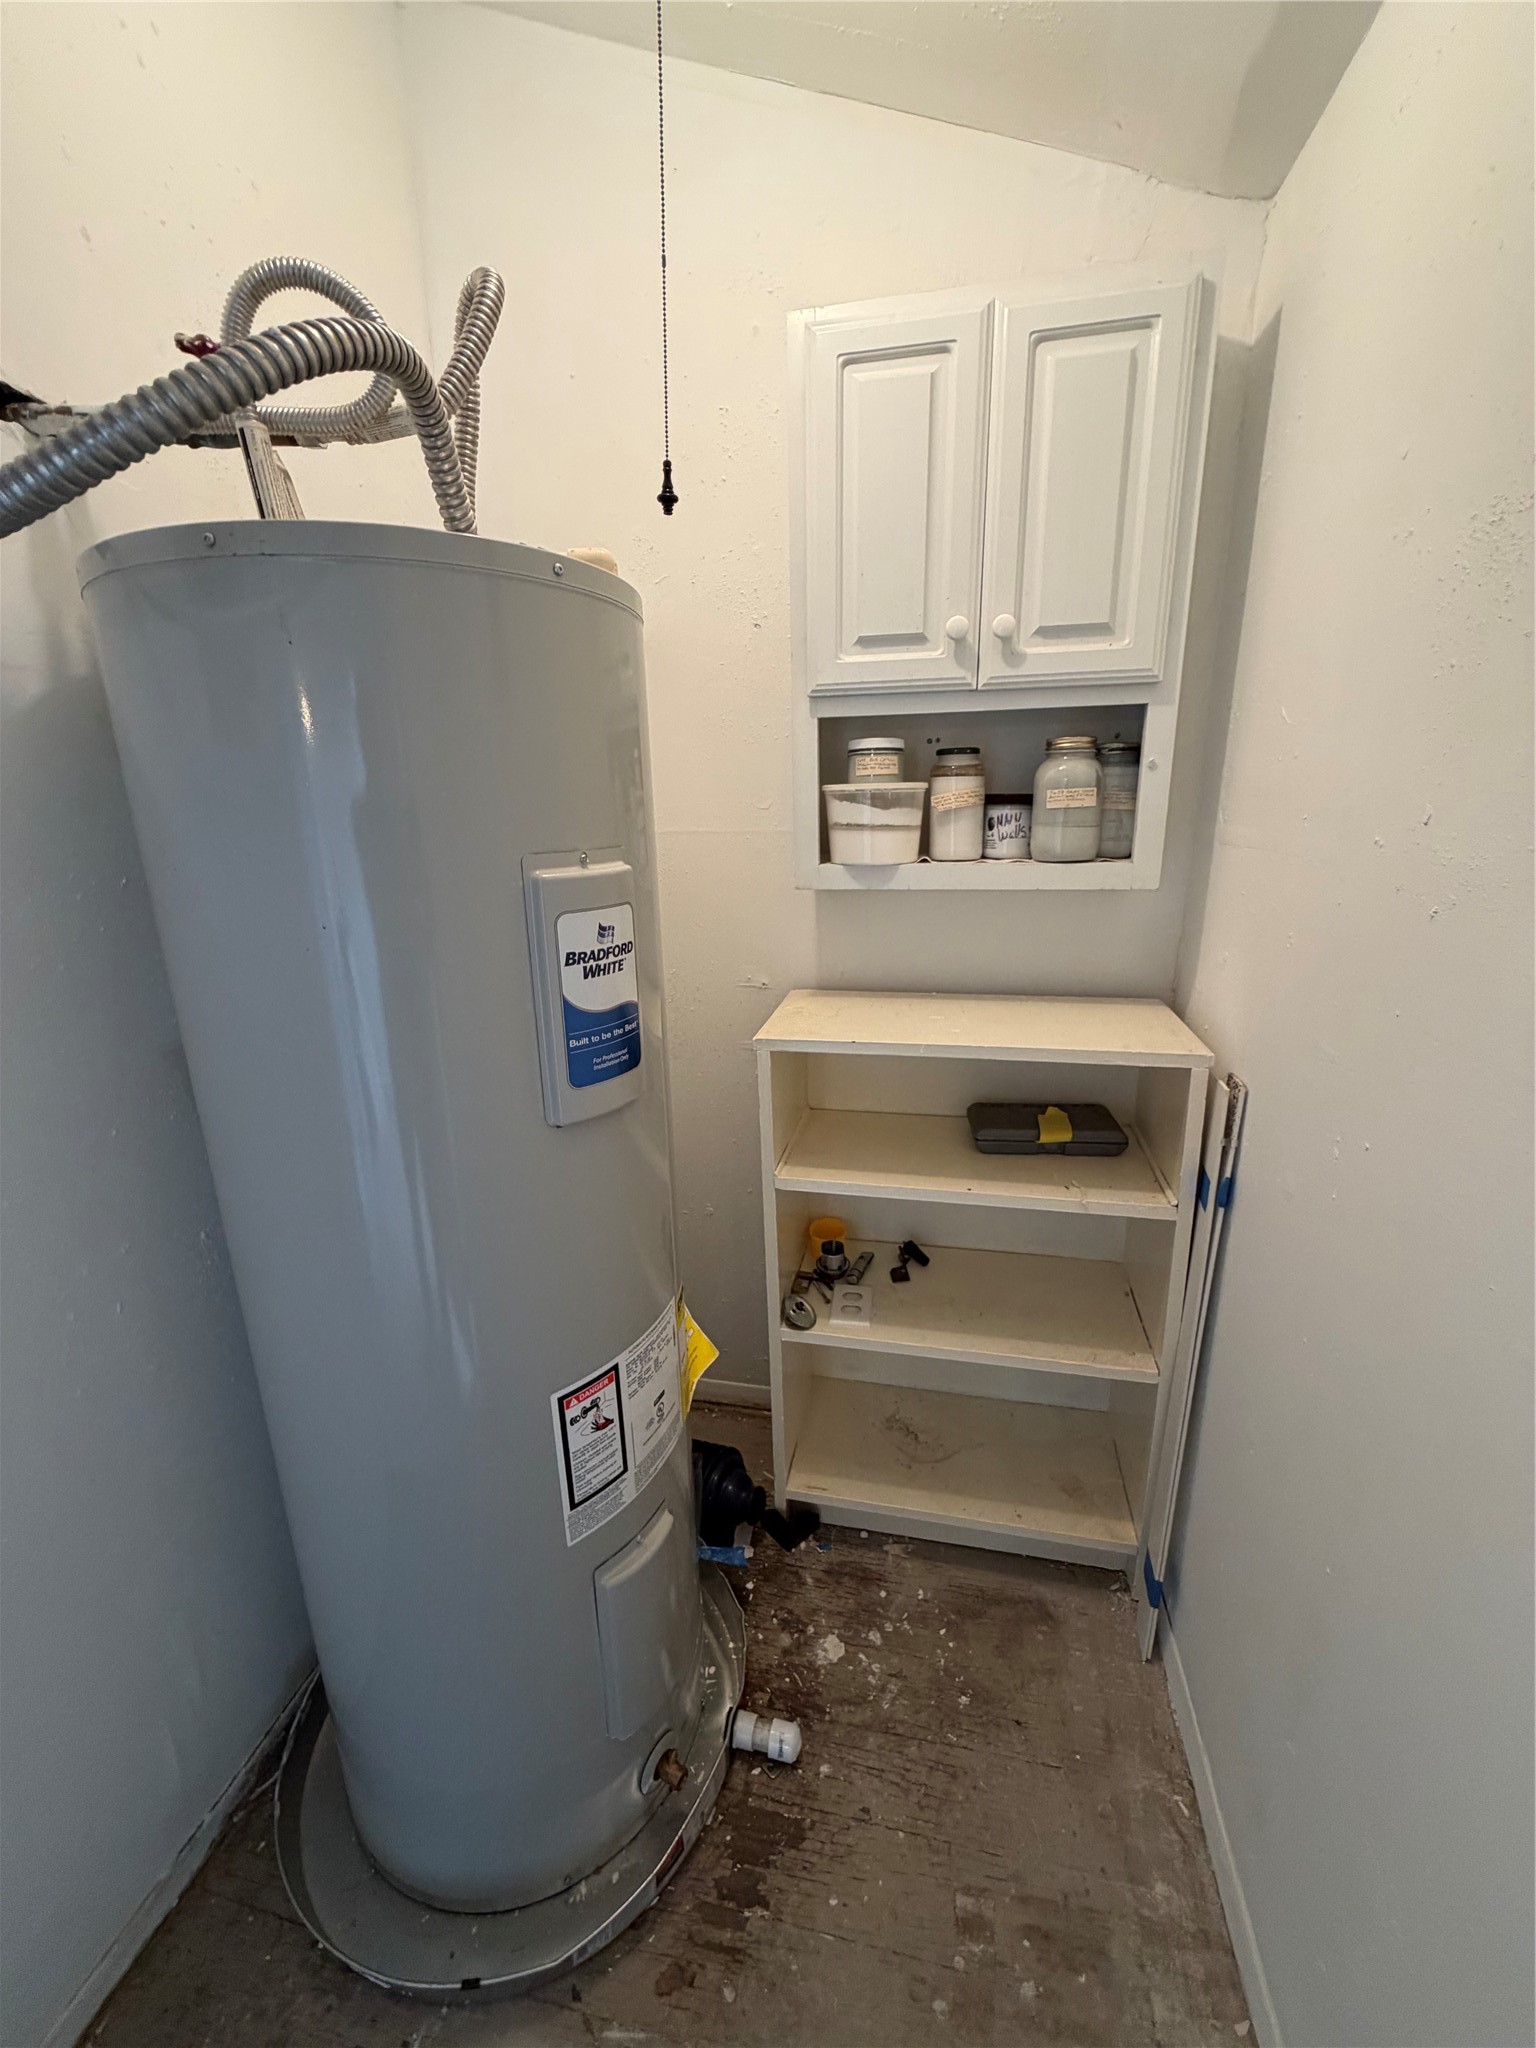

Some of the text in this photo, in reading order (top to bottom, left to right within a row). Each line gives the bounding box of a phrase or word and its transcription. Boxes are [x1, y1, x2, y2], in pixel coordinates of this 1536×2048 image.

[564, 940, 634, 967] BRADFORD
[582, 959, 624, 980] WHITE
[569, 1021, 637, 1048] Built to be the Best
[579, 1378, 609, 1401] DANGER
